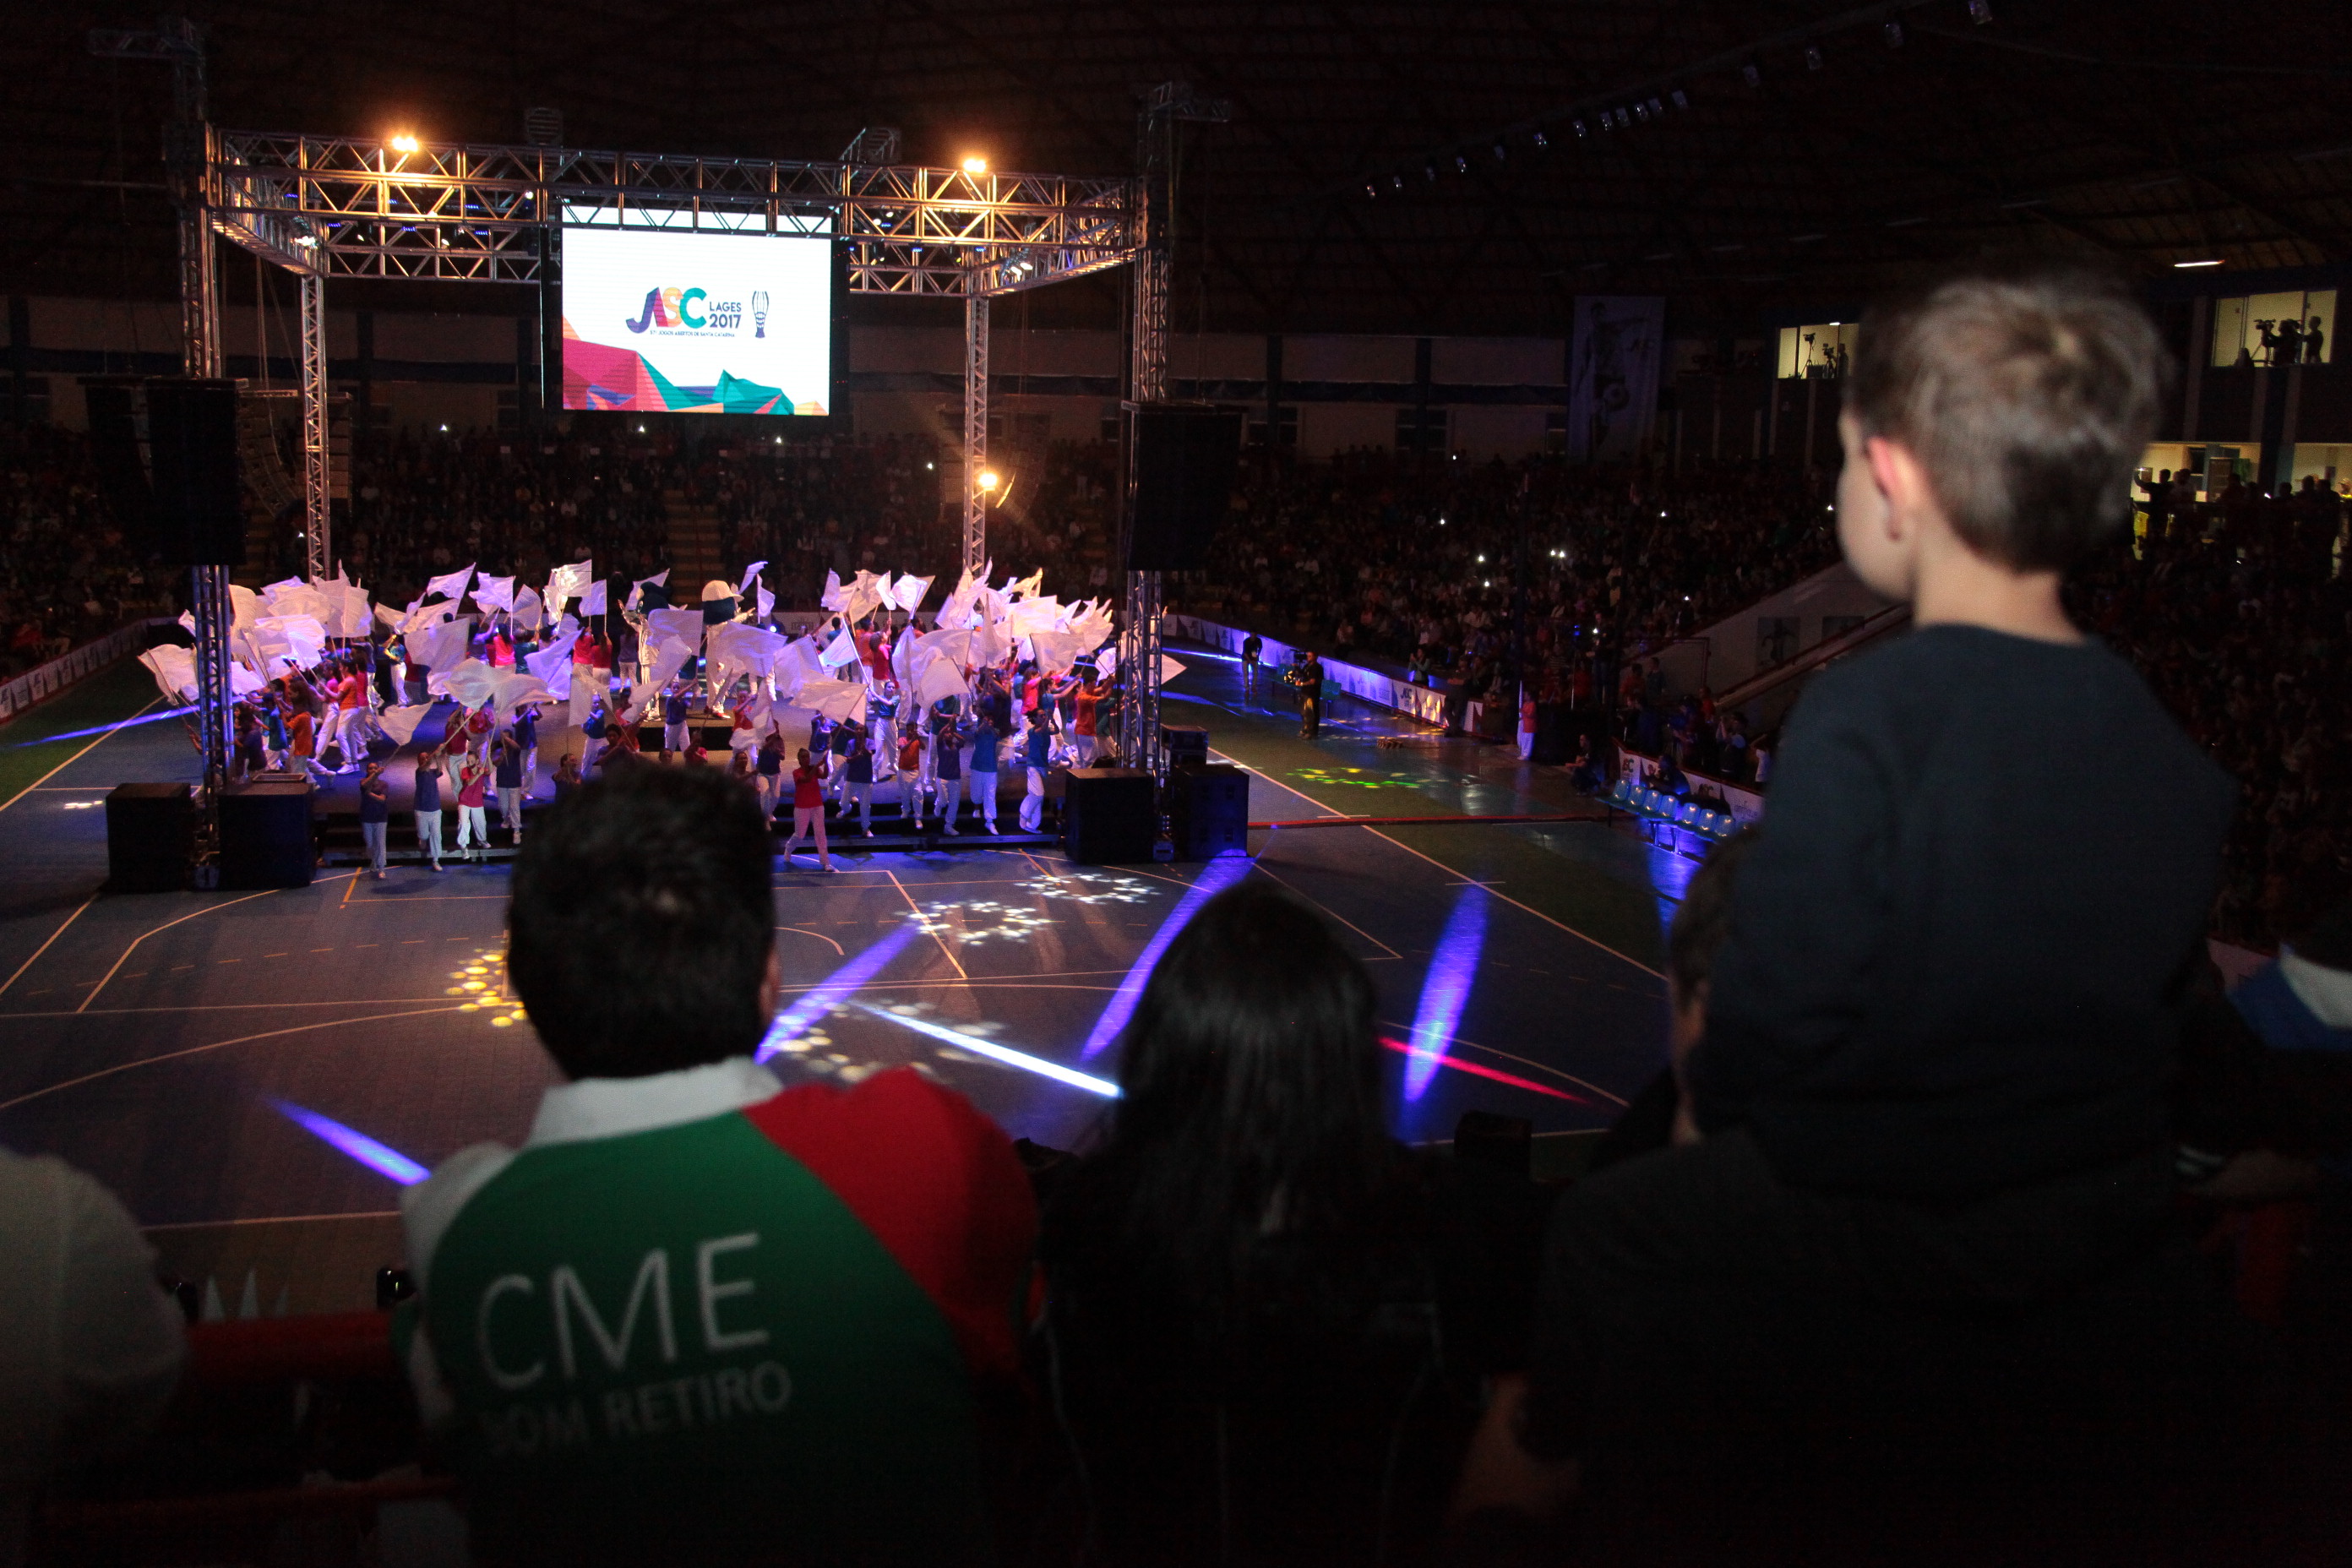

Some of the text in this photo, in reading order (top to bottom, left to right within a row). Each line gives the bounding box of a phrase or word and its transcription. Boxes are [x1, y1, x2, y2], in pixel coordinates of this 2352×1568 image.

[709, 302, 742, 313] LAGES
[709, 313, 742, 329] 2017
[476, 1230, 770, 1391] CME
[601, 1360, 793, 1439] RETIRO
